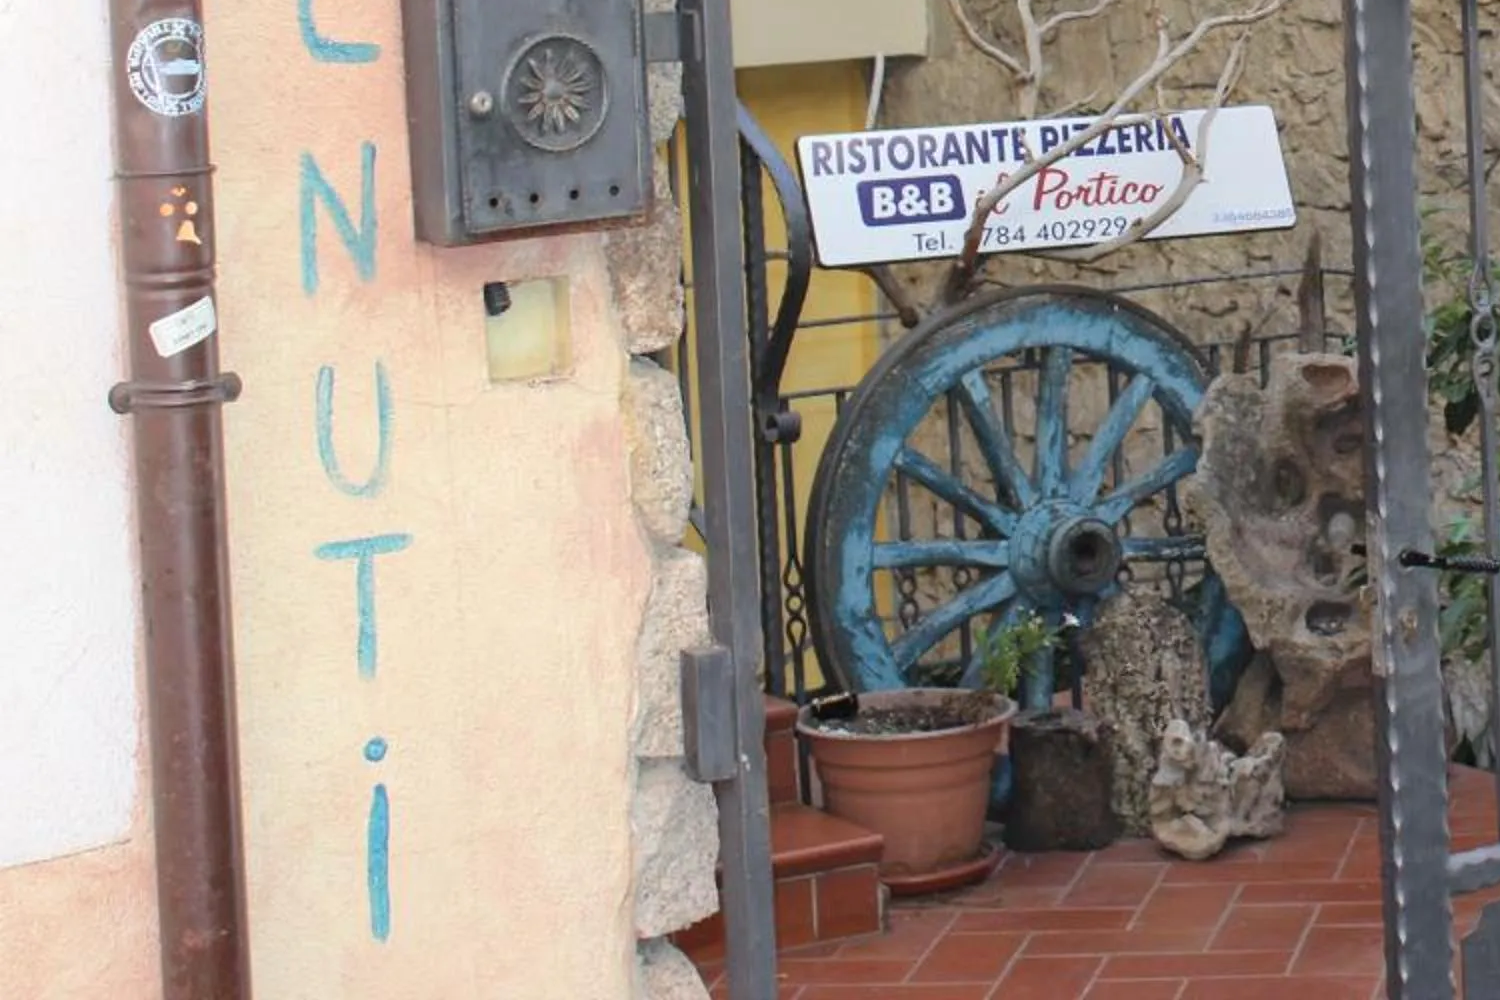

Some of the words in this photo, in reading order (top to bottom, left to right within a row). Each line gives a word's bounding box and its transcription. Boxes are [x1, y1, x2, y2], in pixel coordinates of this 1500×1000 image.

[811, 127, 1026, 176] RISTORANTE
[871, 181, 955, 219] B&B
[1033, 167, 1165, 211] Portico
[913, 231, 954, 252] Tel.
[966, 225, 1025, 247] 784
[1037, 216, 1127, 242] 402929
